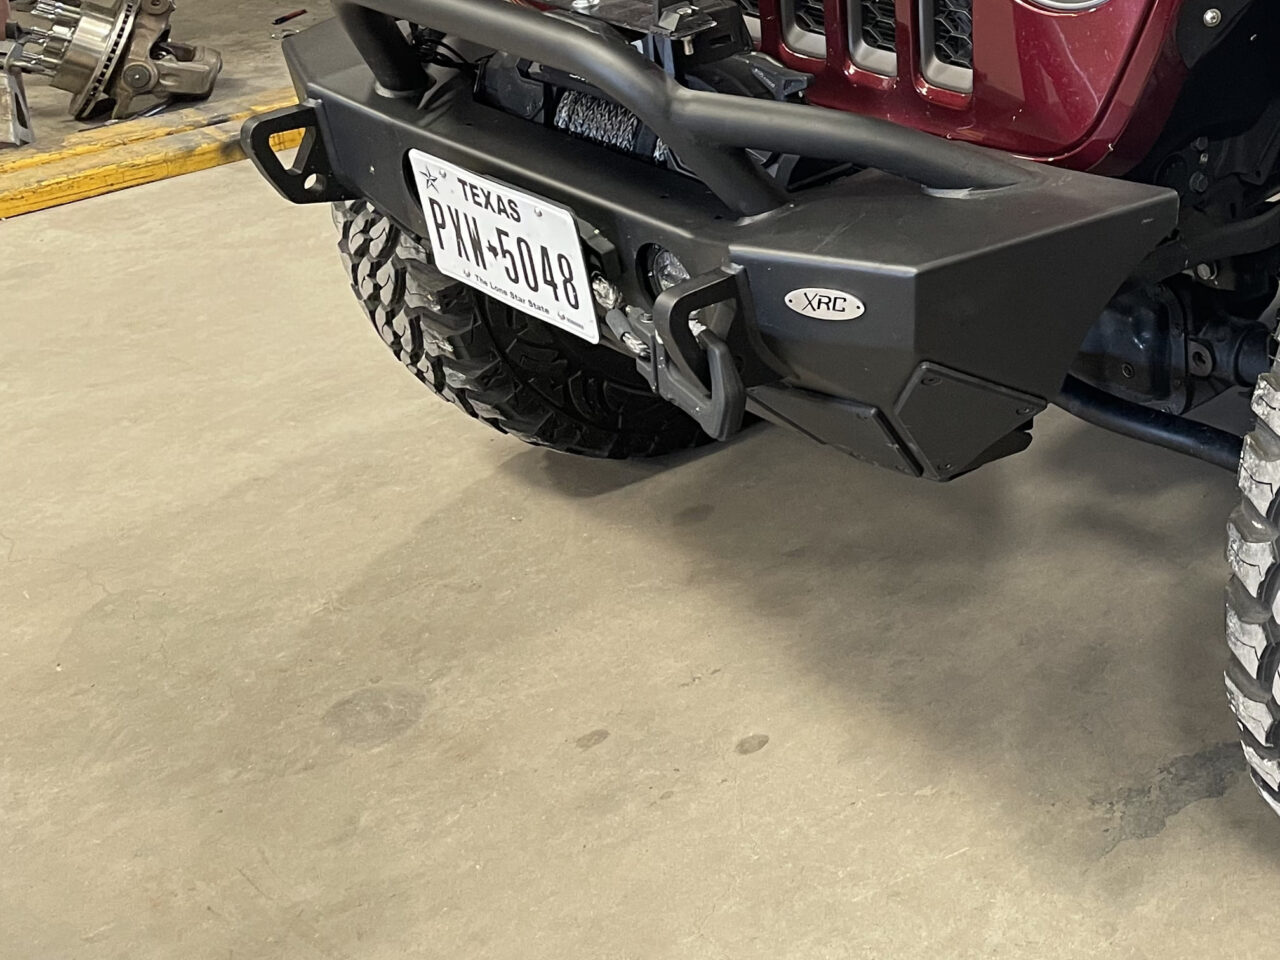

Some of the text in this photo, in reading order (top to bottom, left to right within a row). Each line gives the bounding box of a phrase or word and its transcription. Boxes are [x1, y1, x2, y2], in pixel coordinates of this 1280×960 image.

[456, 177, 522, 223] TEXAS
[474, 274, 550, 314] The Lone Star State
[801, 292, 847, 312] XRC
